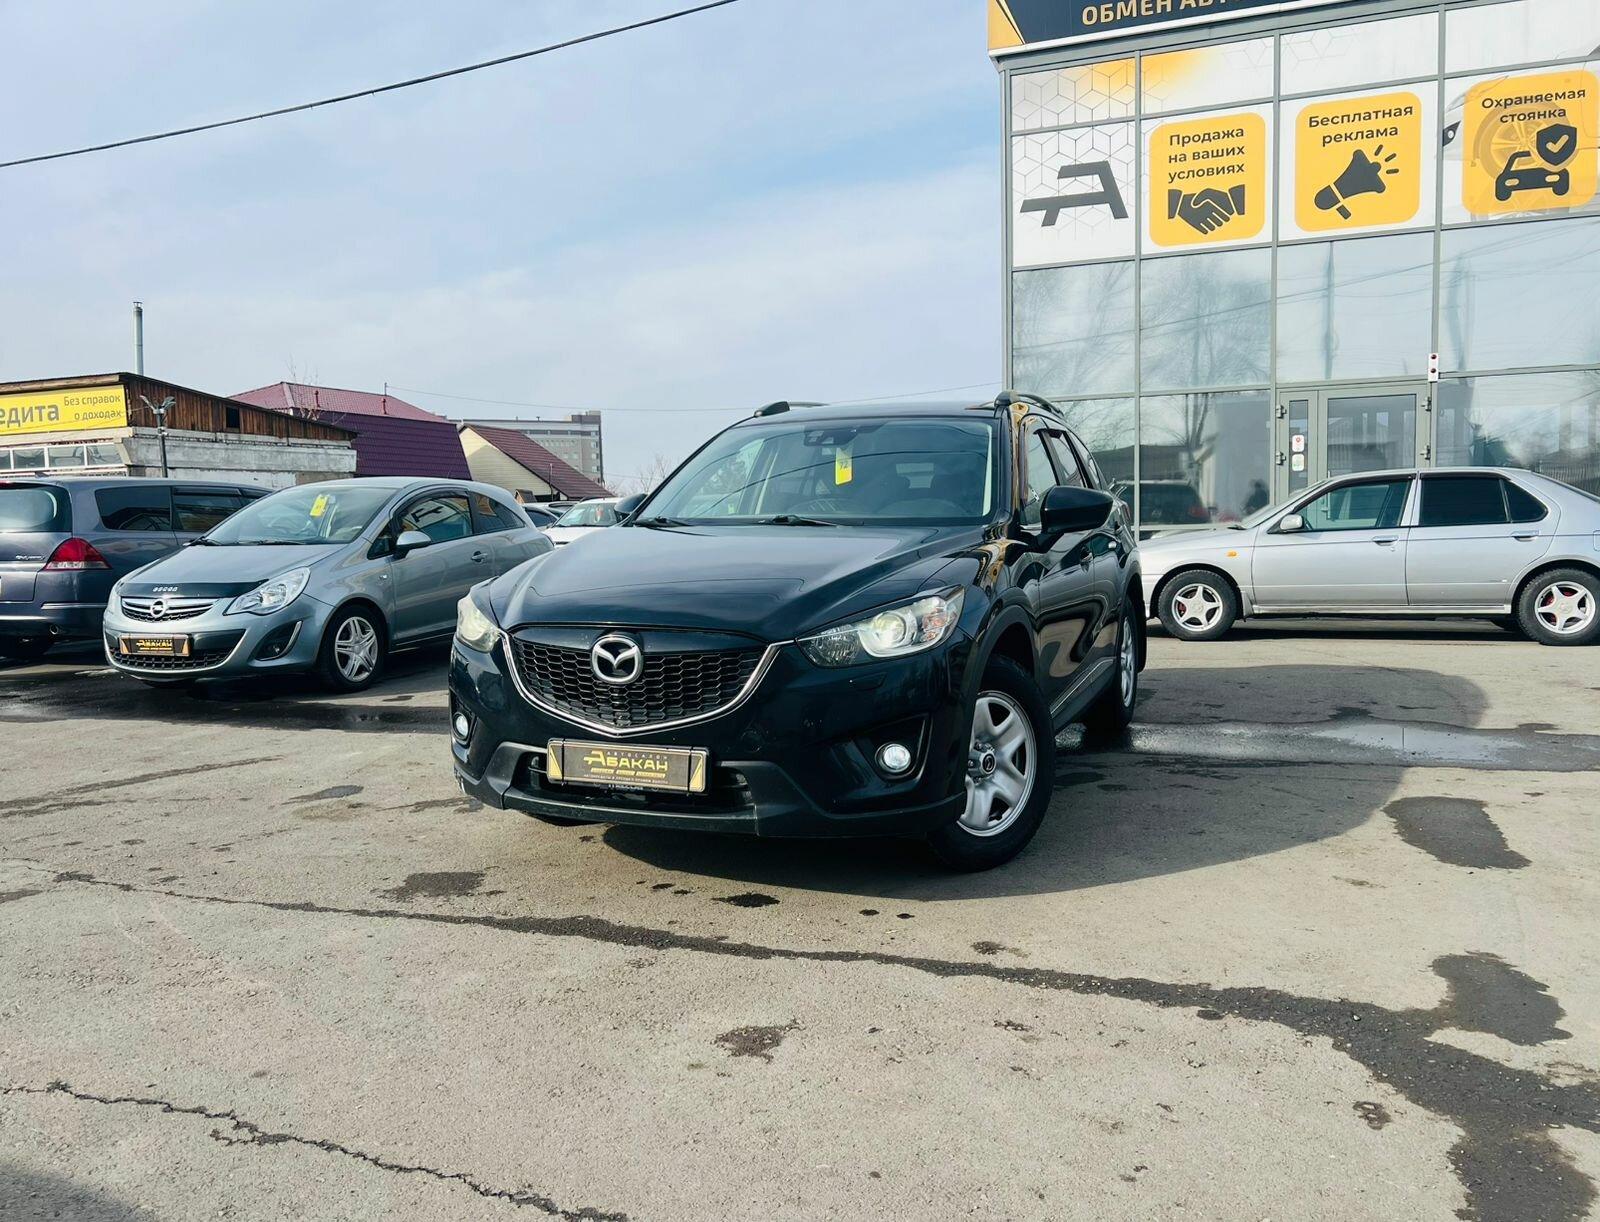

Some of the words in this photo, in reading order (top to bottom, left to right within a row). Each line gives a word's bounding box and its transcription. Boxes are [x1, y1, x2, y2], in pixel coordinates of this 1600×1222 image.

[1082, 0, 1173, 26] ОБМЕН
[1481, 89, 1587, 110] Охраняемая
[1308, 105, 1414, 129] Бесплатная
[1499, 108, 1567, 124] стоянка
[1168, 127, 1245, 148] Продажа
[1321, 125, 1399, 148] реклама
[1167, 153, 1188, 165] на
[1191, 144, 1246, 162] ваших
[1167, 162, 1246, 184] условиях
[63, 396, 80, 407] Без
[81, 394, 122, 407] справок
[74, 412, 81, 421] о
[82, 409, 122, 421] доходах
